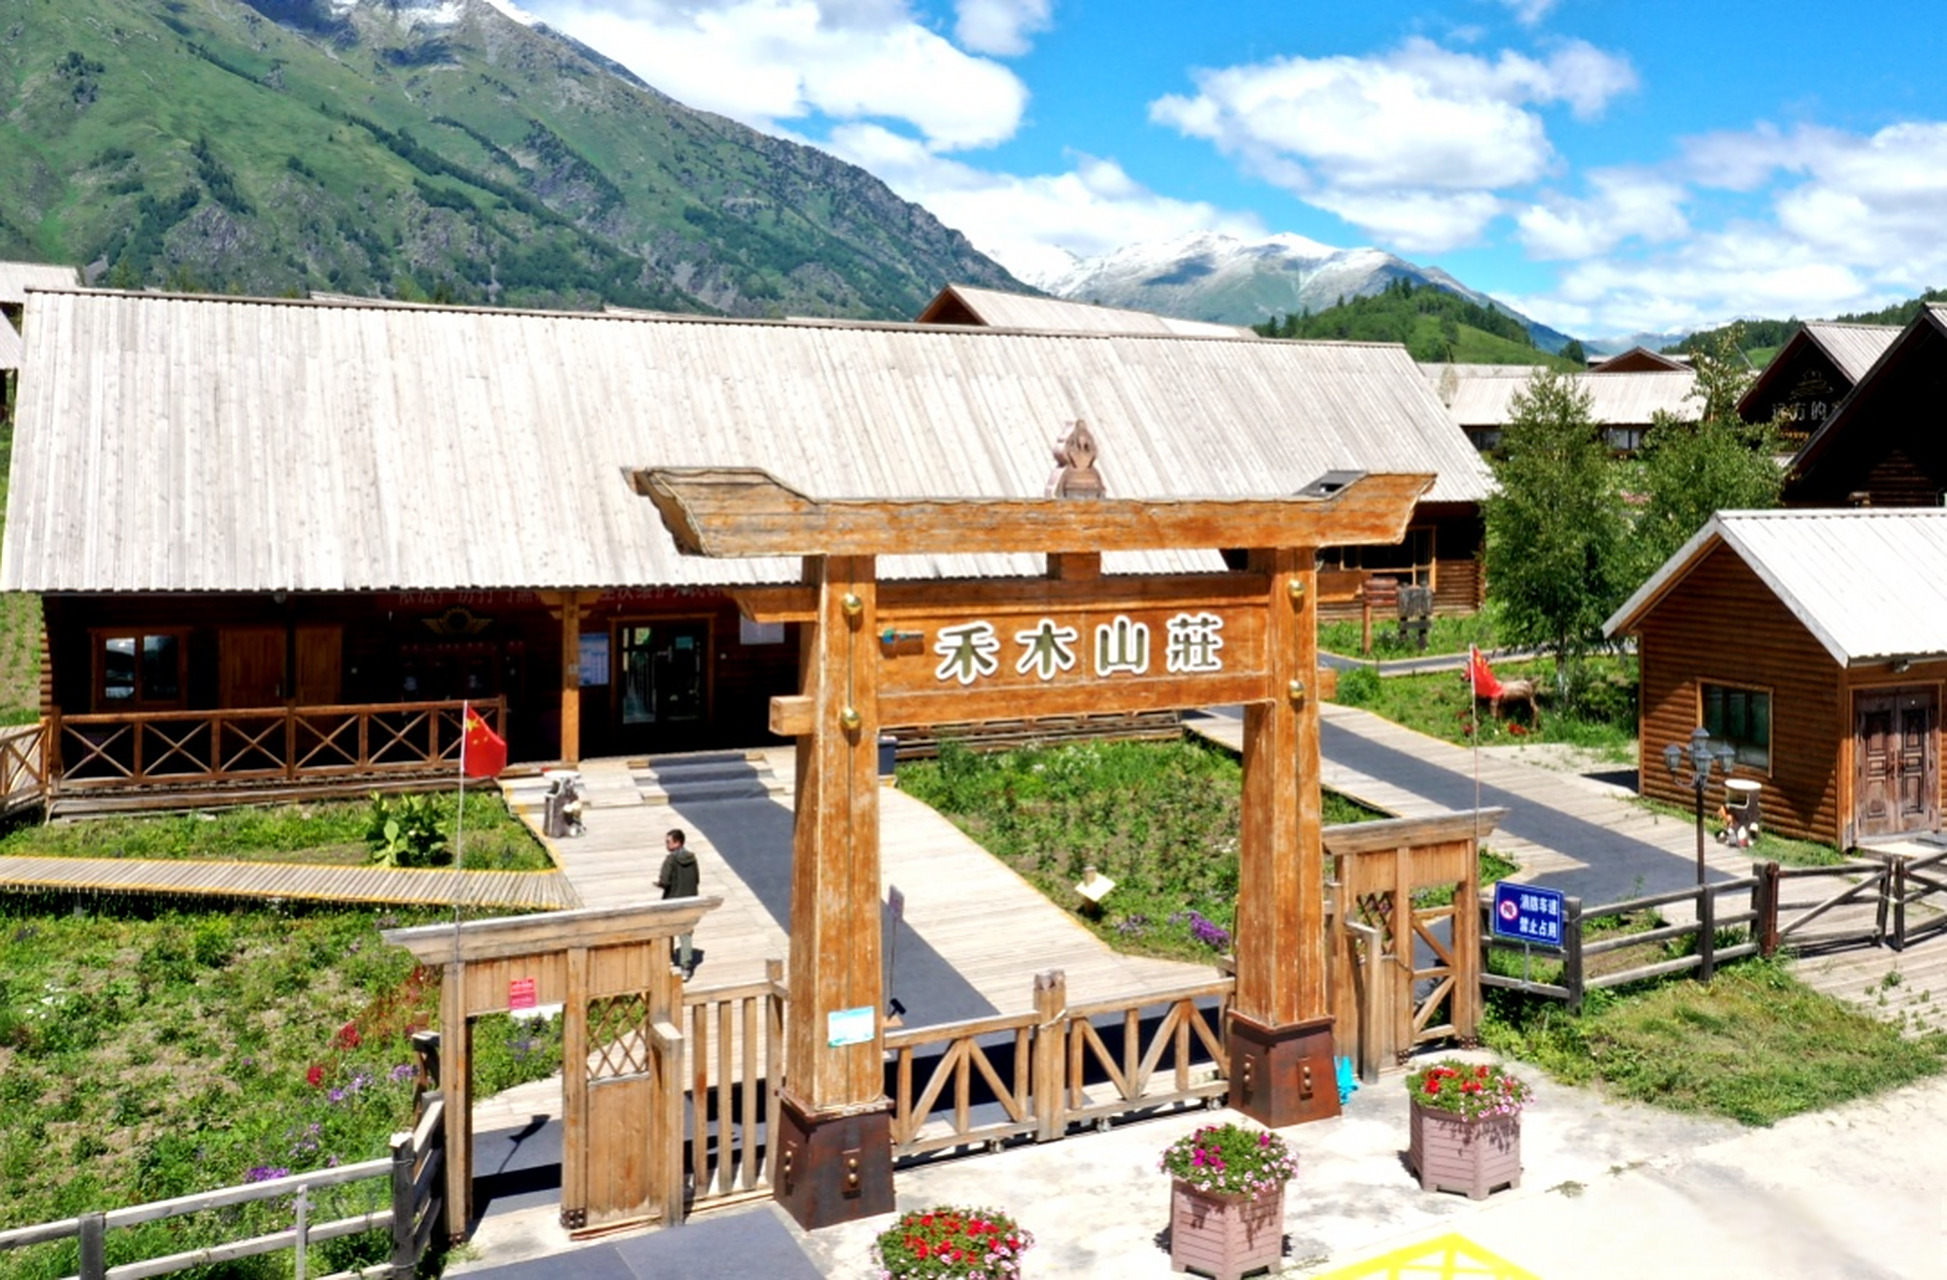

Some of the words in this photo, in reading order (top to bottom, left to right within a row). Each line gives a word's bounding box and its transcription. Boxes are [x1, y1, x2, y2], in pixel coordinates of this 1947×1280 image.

[934, 613, 1223, 684] 禾木山莊
[1519, 917, 1557, 938] 禁止占用
